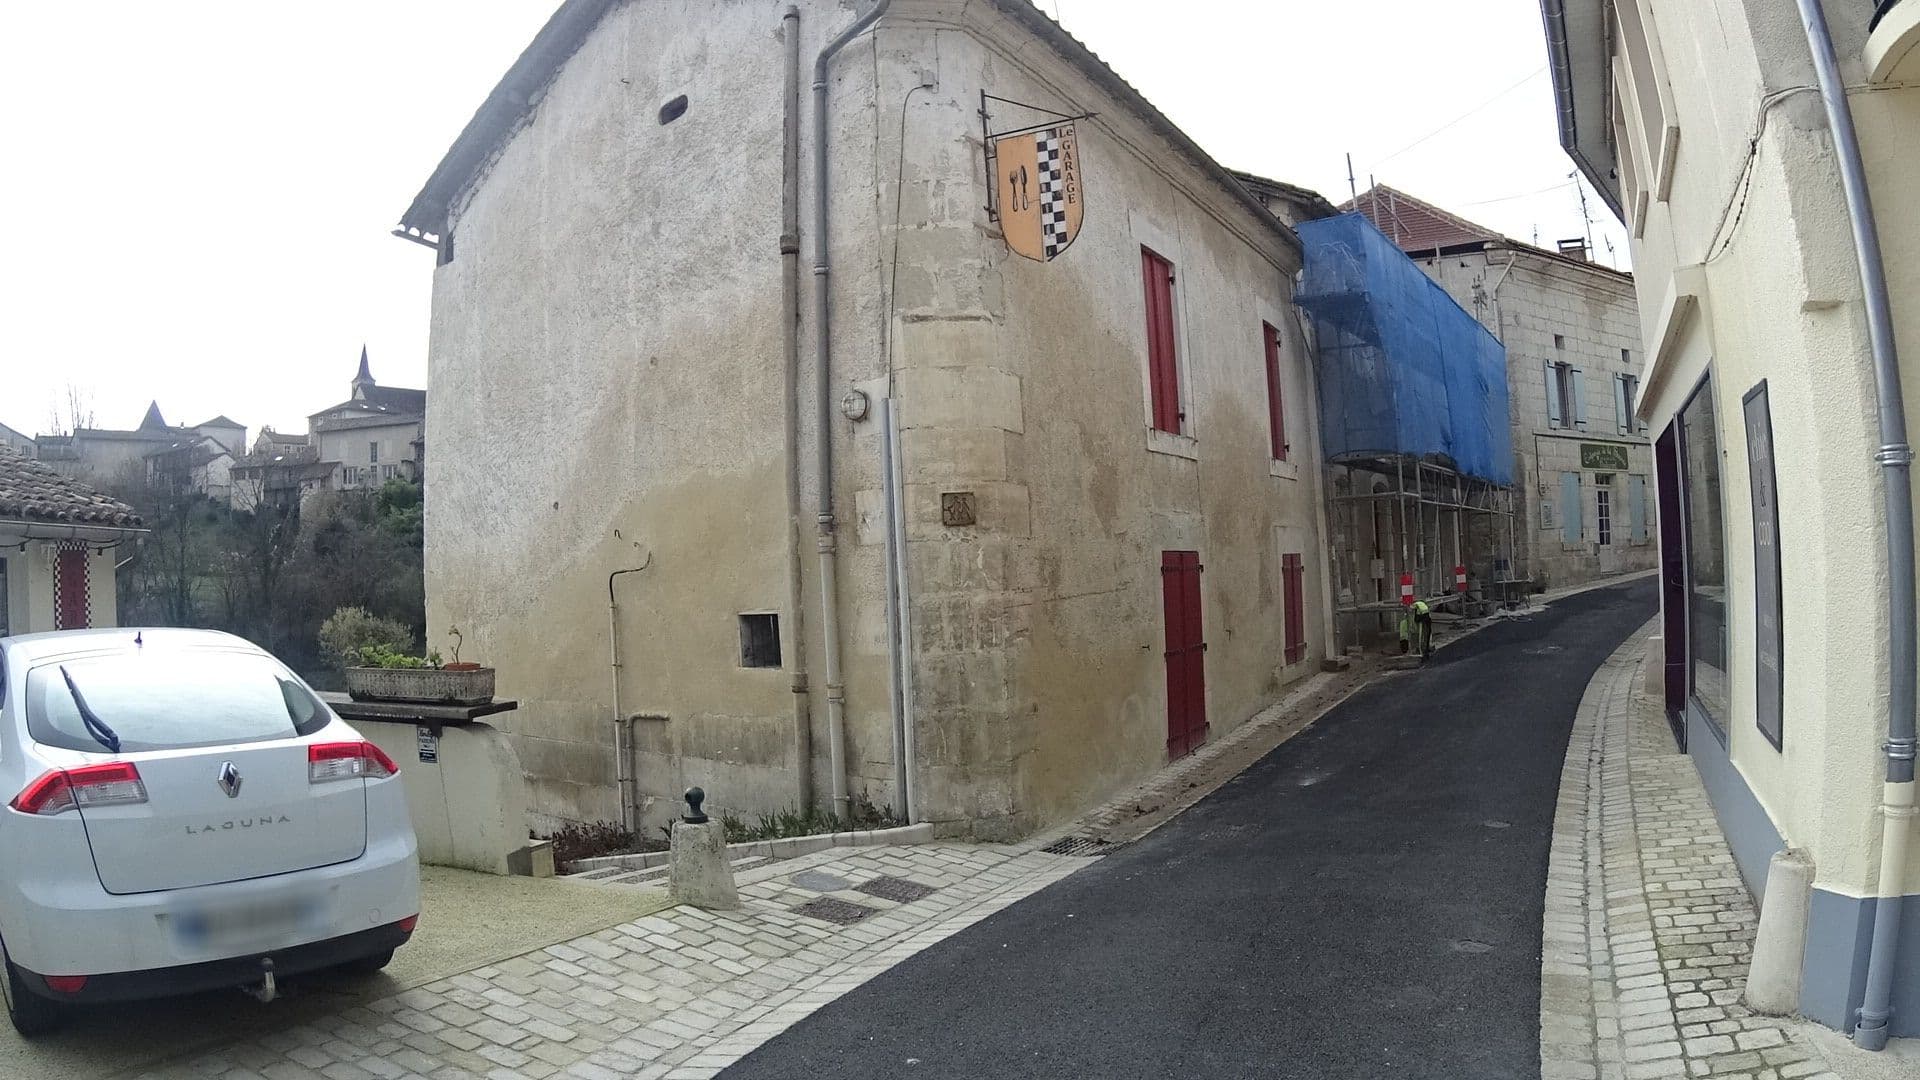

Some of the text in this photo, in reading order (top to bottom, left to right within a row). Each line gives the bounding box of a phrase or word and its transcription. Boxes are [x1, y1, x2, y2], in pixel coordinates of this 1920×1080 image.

[1059, 128, 1073, 138] Le
[1061, 140, 1077, 205] GARAGE
[184, 816, 291, 835] LAGUNA
